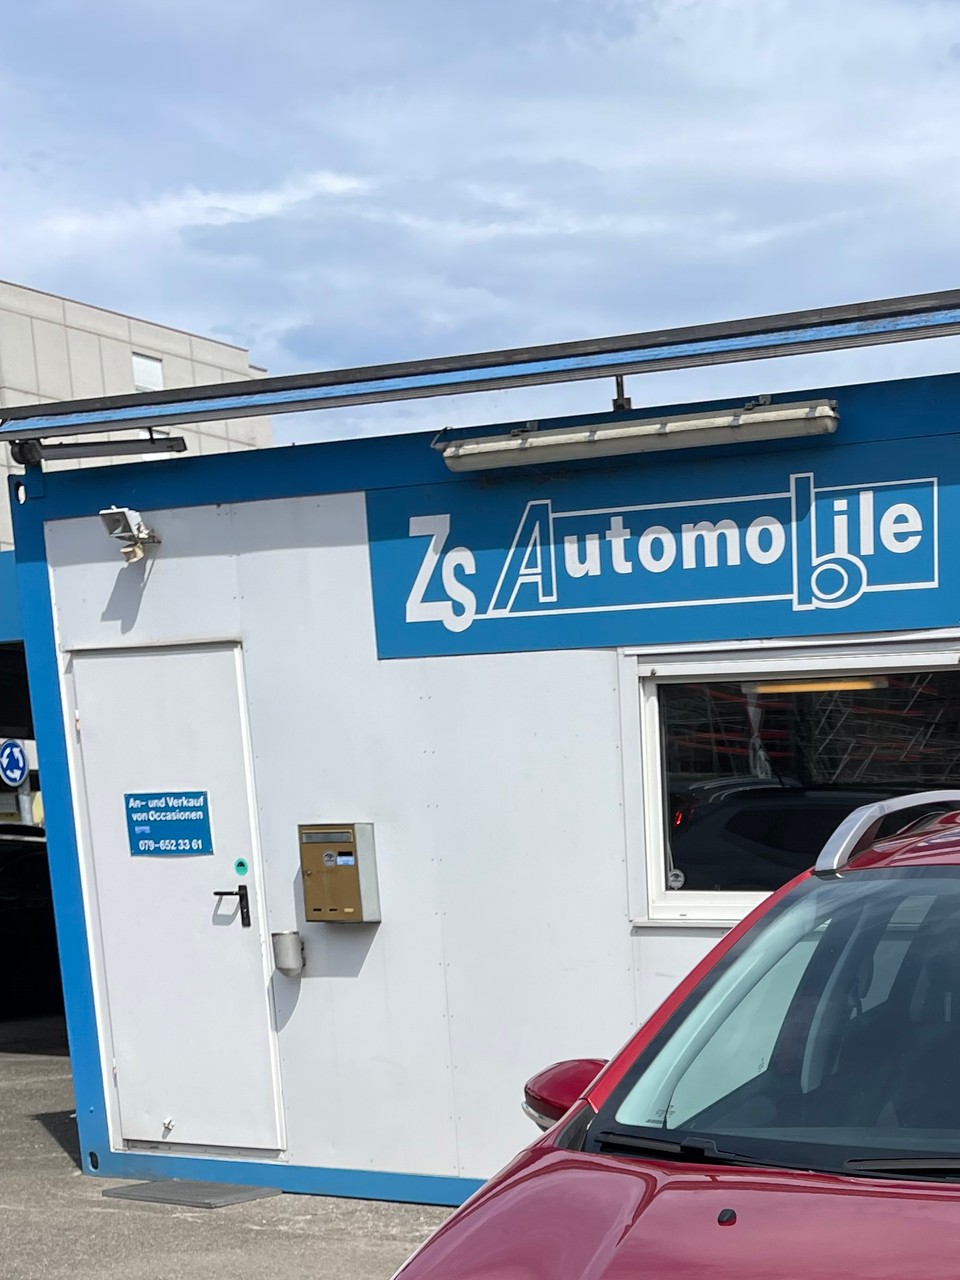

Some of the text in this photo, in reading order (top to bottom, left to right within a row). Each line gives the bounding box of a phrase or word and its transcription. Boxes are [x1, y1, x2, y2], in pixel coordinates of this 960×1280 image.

[405, 473, 924, 633] Zs Automobile
[128, 795, 205, 808] An- und Verkauf
[132, 809, 204, 821] von Occasionen
[138, 838, 203, 851] 079-652 33 61
